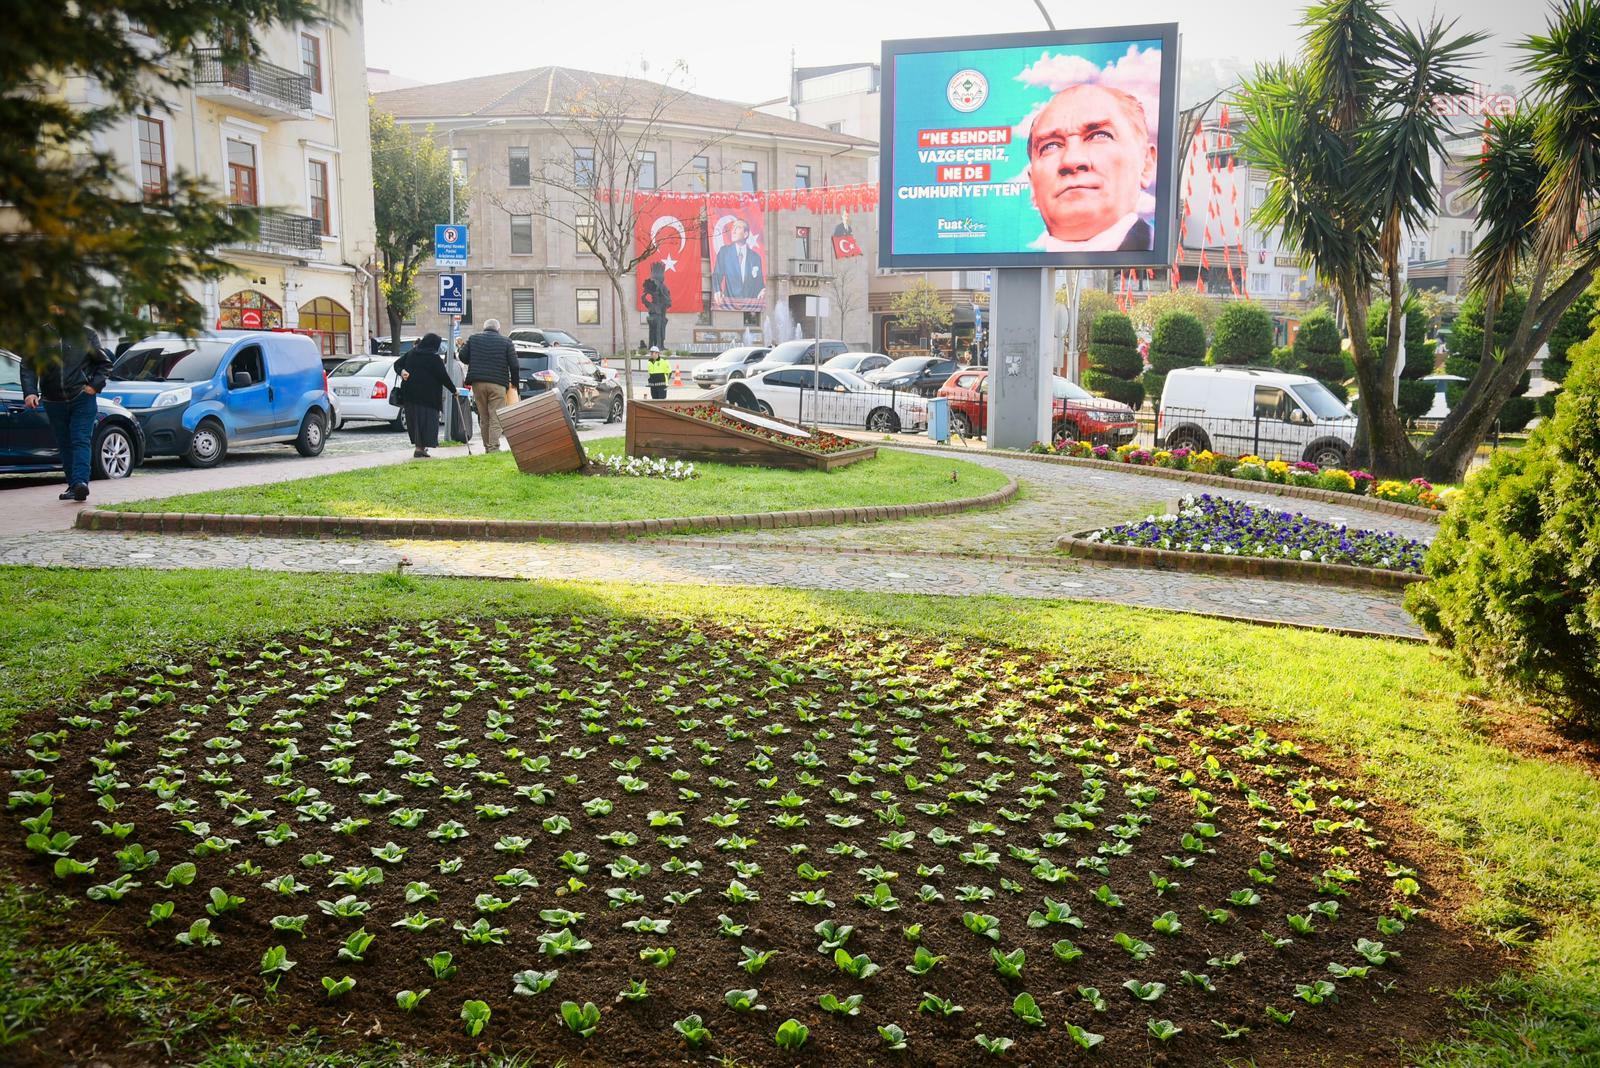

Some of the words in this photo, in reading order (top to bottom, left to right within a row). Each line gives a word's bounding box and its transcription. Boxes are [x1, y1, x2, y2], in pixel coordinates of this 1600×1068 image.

[950, 129, 1007, 144] SENDEN
[918, 145, 1009, 165] VAZGEÇERİZ,
[943, 167, 962, 180] NE
[964, 166, 983, 179] DE
[937, 218, 963, 230] Fuat
[441, 276, 454, 296] P
